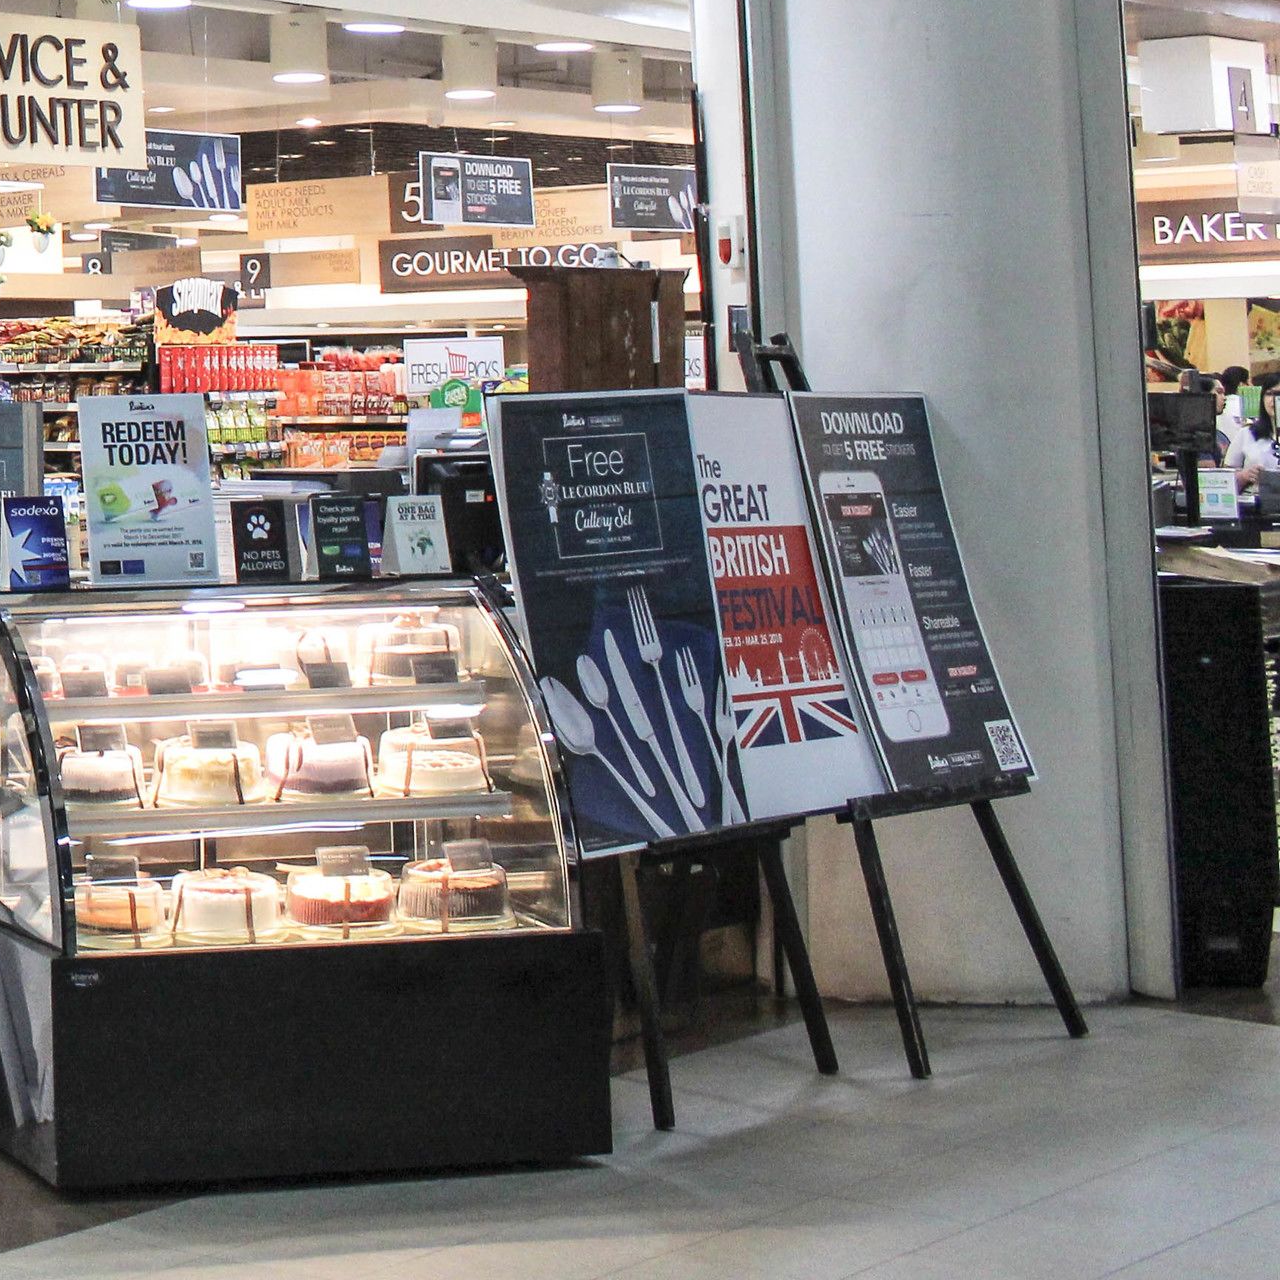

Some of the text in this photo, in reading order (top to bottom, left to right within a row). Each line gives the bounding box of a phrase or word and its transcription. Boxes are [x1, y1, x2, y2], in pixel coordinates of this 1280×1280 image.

[101, 42, 130, 91] &
[156, 156, 176, 168] BLEU
[464, 161, 514, 178] DOWNLOAD
[23, 165, 65, 183] CEREALS
[254, 184, 327, 198] BAKING NEEDS
[466, 179, 522, 196] TO GET 5 FREE
[631, 185, 655, 197] CORDON
[256, 195, 311, 210] ADULT MILK
[401, 181, 422, 223] 5
[466, 193, 498, 206] STICKERS
[256, 204, 335, 219] MILK PRODUCTS
[276, 219, 299, 230] MILK
[500, 224, 604, 241] BEAUTY ACCESSORIES
[1152, 211, 1280, 245] BAKER
[391, 242, 602, 277] GOURMET TO GO
[246, 258, 261, 284] 9
[410, 361, 448, 385] FRESH
[820, 411, 904, 435] DOWNLOAD
[101, 420, 186, 444] REDEEM
[103, 442, 188, 467] TODAY!
[844, 439, 888, 461] 5 FREE
[567, 444, 625, 478] Free
[696, 454, 722, 479] The
[562, 481, 649, 500] LE CORDON BLEU
[10, 504, 59, 517] sodexo
[319, 505, 355, 515] Check your
[397, 505, 436, 515] ONE BAG
[702, 483, 771, 523] GREAT
[892, 502, 918, 518] Easier
[399, 513, 408, 521] AT
[417, 513, 436, 521] TIME
[243, 550, 281, 561] NO PETS
[708, 533, 790, 579] BRITISH
[241, 560, 286, 571] ALLOWED
[908, 563, 933, 578] Faster
[716, 584, 826, 632] FESTIVAL
[922, 616, 961, 631] Shareable
